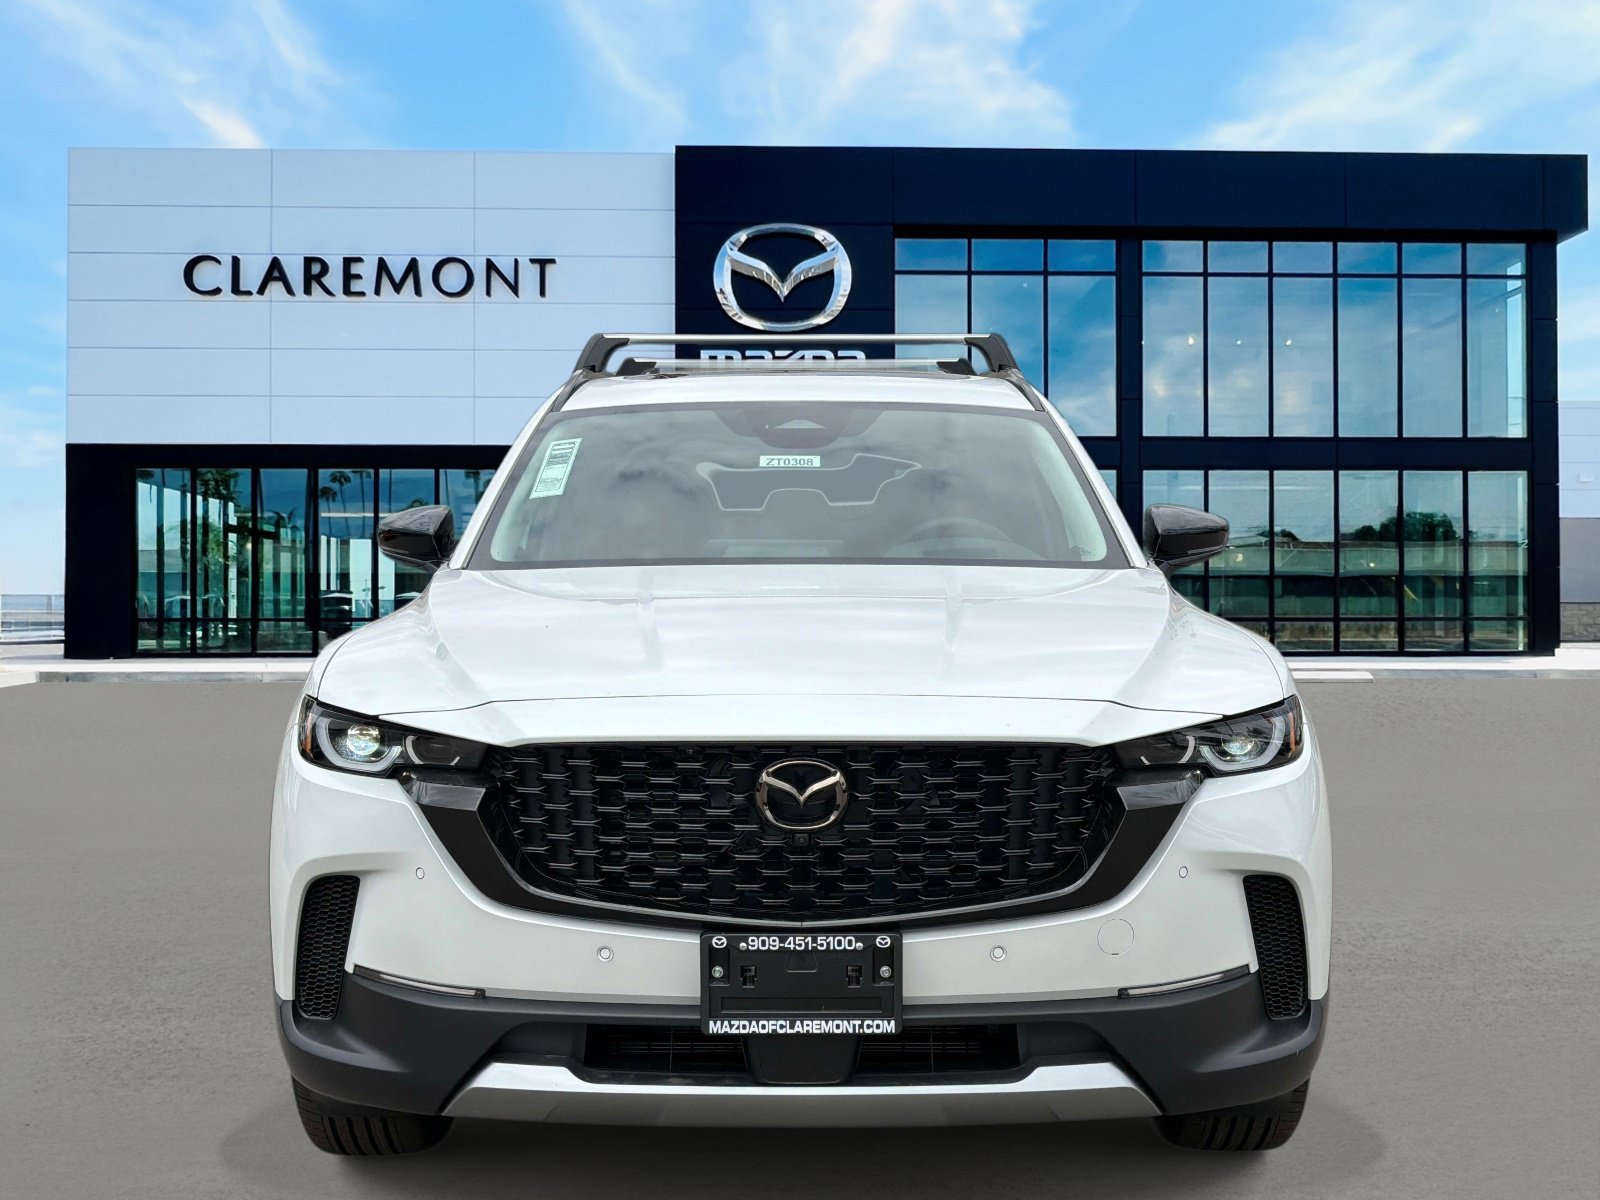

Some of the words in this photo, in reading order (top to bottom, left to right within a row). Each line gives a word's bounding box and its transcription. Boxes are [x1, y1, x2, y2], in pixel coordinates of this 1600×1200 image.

[183, 255, 557, 298] CLAREMONT
[766, 457, 814, 466] ZT0308
[748, 936, 856, 951] 909-451-5100
[709, 1020, 895, 1034] MAZDAOFCLAREMONT.COM
